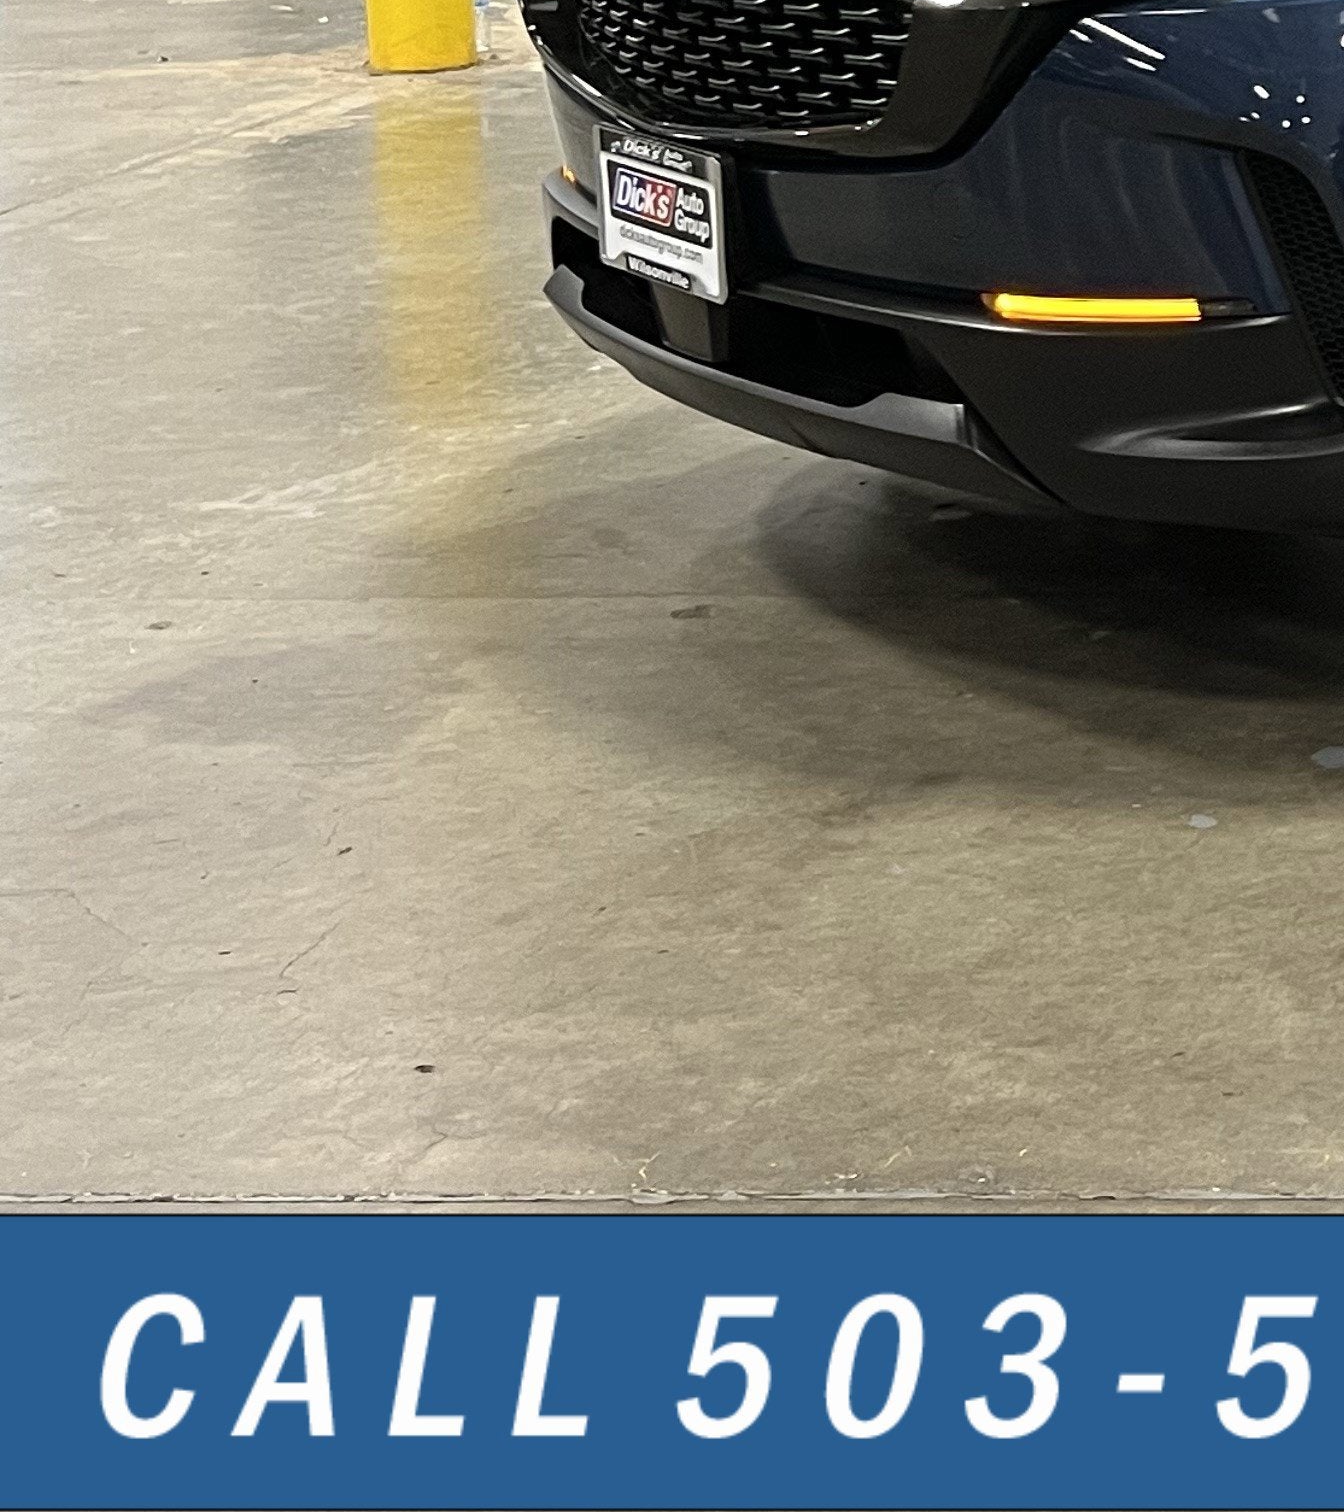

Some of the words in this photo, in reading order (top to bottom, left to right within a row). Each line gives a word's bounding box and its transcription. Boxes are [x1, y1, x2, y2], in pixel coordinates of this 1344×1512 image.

[616, 174, 671, 220] Dick's
[676, 187, 705, 216] Auto
[674, 208, 710, 243] Group
